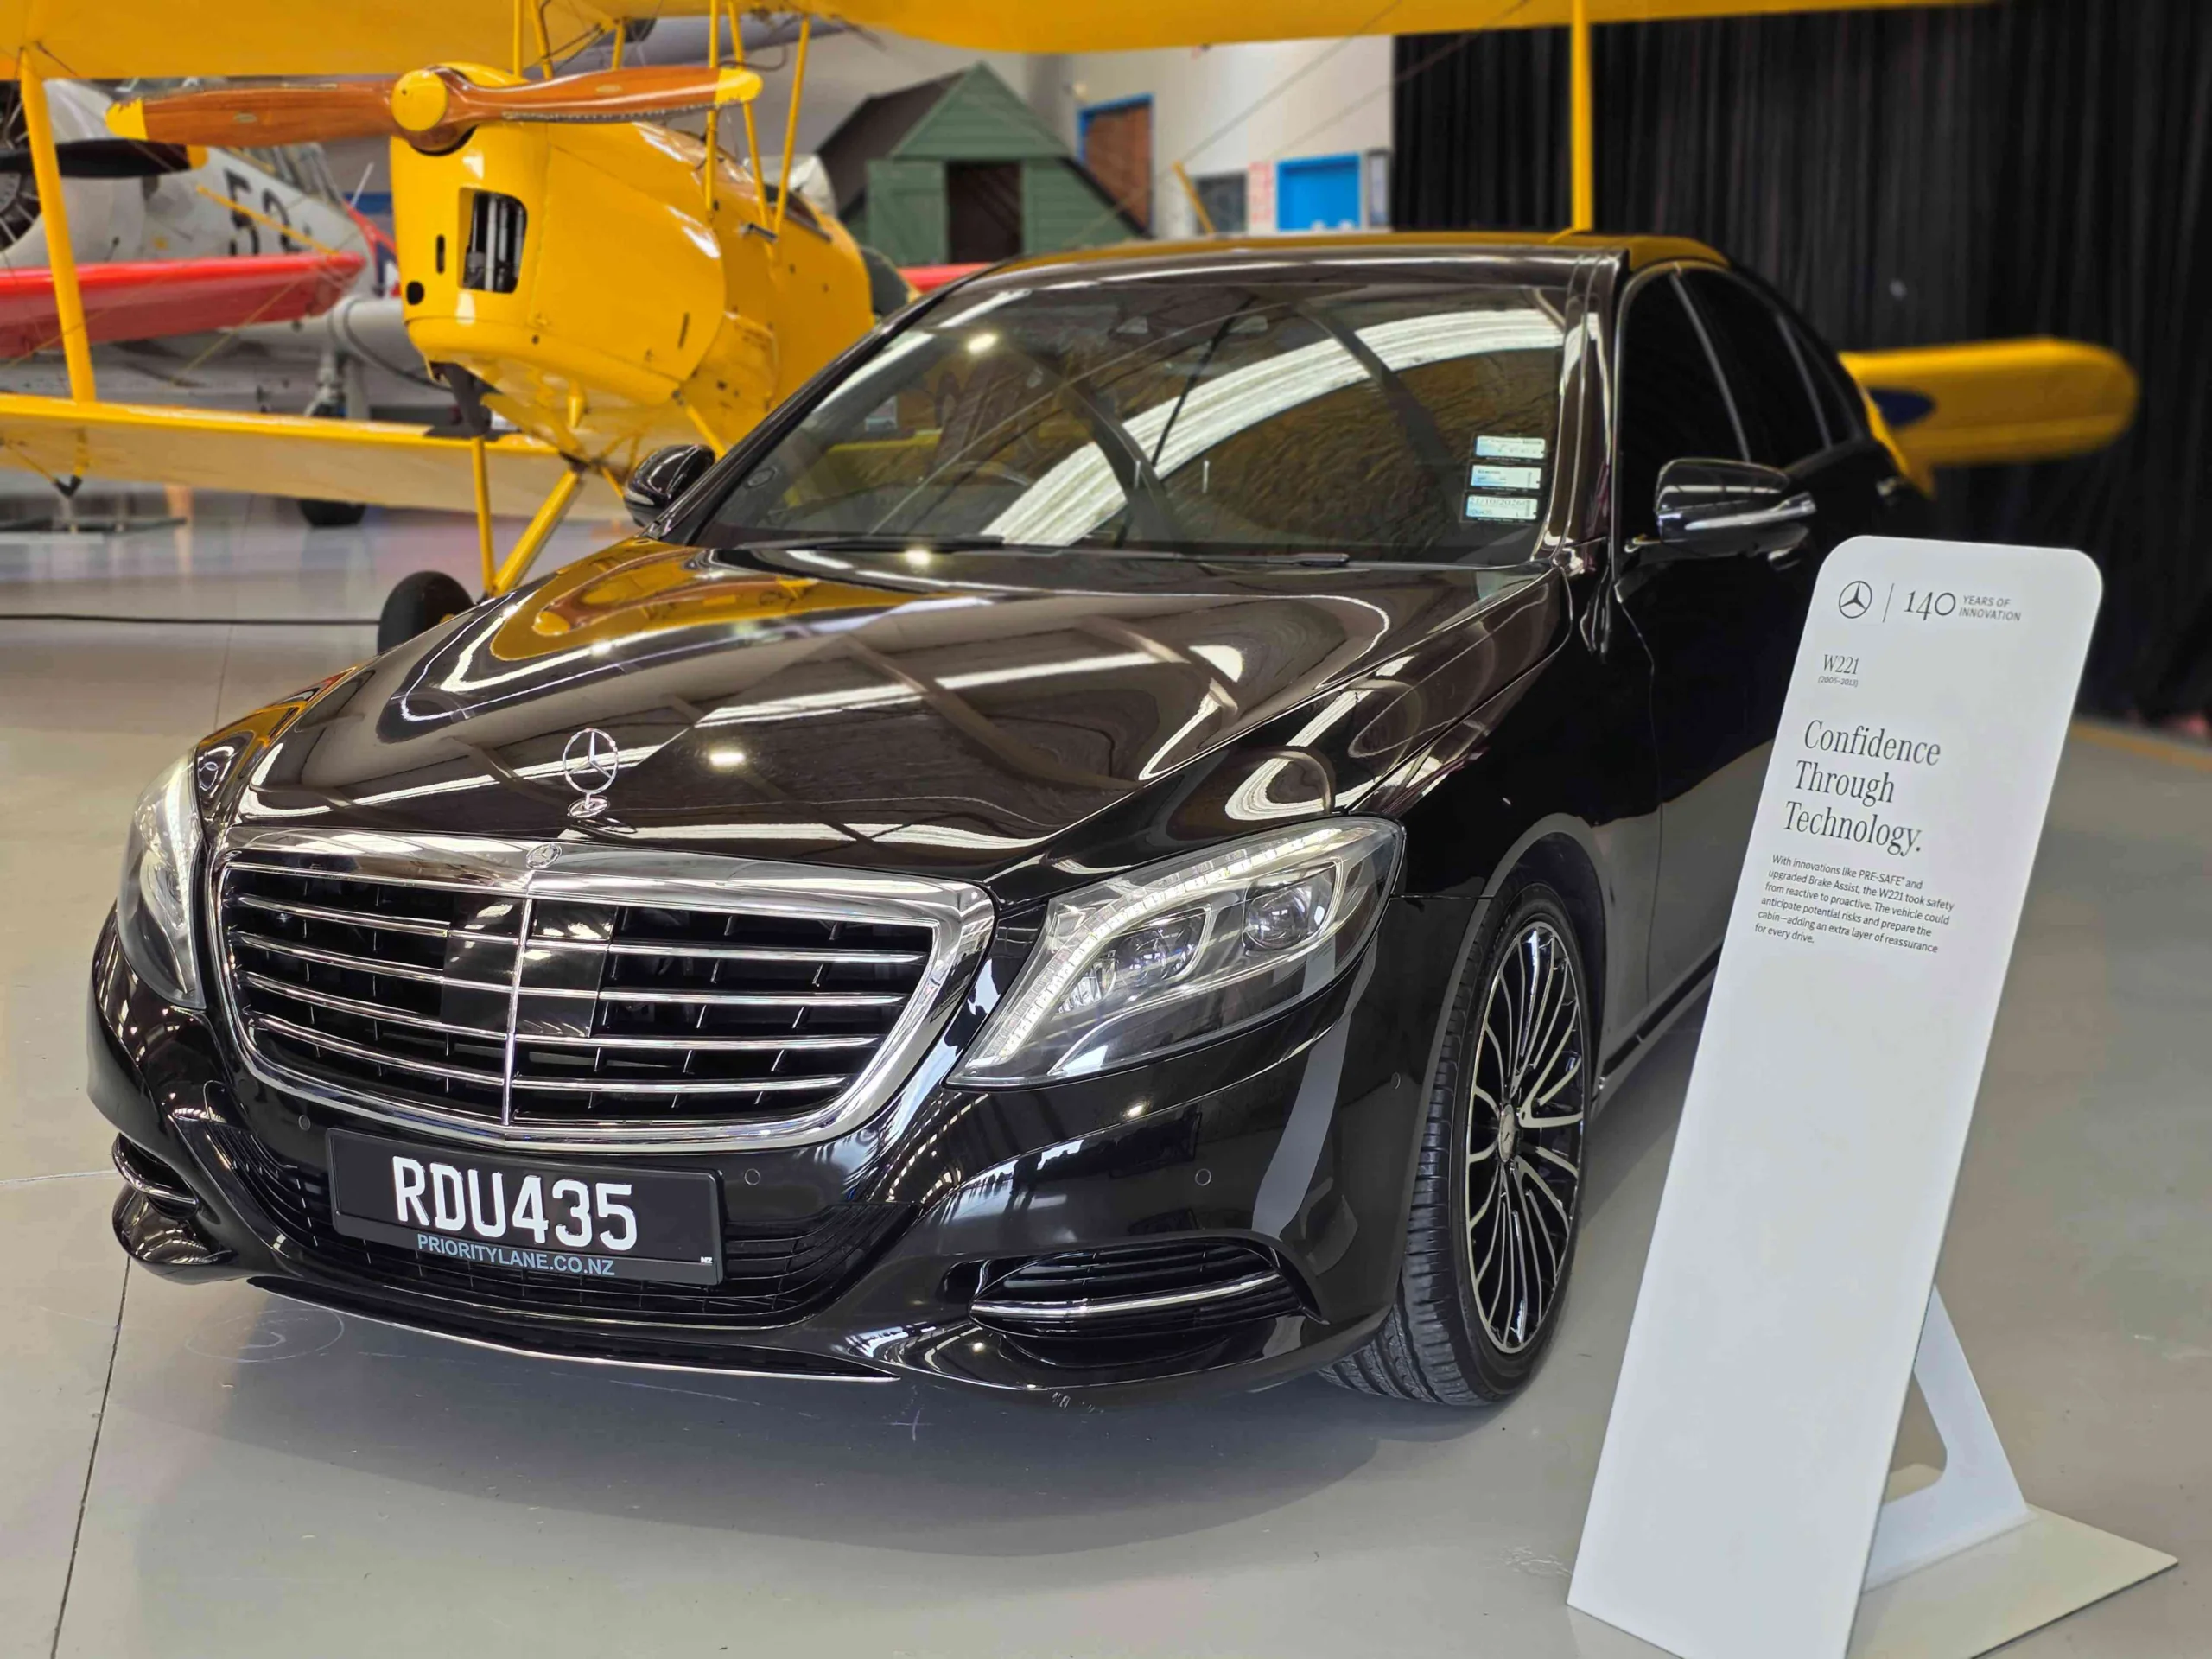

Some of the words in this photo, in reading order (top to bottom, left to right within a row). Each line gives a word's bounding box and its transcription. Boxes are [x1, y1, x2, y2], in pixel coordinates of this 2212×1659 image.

[1904, 590, 1956, 620] 140
[1959, 607, 2021, 621] INNOVATION
[1963, 595, 1994, 607] YEARS
[1996, 598, 2011, 607] OF
[1823, 654, 1859, 675] W221
[1804, 719, 1941, 766] Confidence
[1795, 760, 1894, 807] Through
[1783, 801, 1922, 857] Technology.
[1769, 870, 1808, 883] upgraded
[1808, 875, 1832, 888] Brake
[1833, 880, 1859, 894] Assist,
[1863, 886, 1877, 896] the
[1879, 888, 1903, 900] W221
[1905, 894, 1925, 906] took
[1926, 899, 1955, 912] safety
[1772, 855, 1791, 866] With
[1793, 858, 1840, 874] innovations
[1842, 867, 1857, 878] like
[1905, 880, 1923, 889] and
[1762, 897, 1802, 911] anticipate
[1802, 906, 1840, 918] potential
[1842, 912, 1861, 923] risks
[1863, 917, 1880, 926] and
[1881, 920, 1915, 933] prepare
[1917, 925, 1932, 937] the
[1765, 881, 1783, 893] from
[1786, 887, 1818, 899] reactive
[1830, 896, 1872, 910] proactive.
[1874, 902, 1890, 913] The
[1892, 907, 1923, 919] vehicle
[1924, 913, 1950, 925] could
[1755, 923, 1766, 932] for
[1768, 927, 1790, 940] every
[1791, 931, 1815, 943] drive.
[1828, 925, 1850, 936] extra
[1852, 927, 1873, 940] layer
[1874, 933, 1884, 942] of
[1885, 937, 1938, 953] reassurance
[392, 1155, 638, 1251] RDU435
[417, 1233, 615, 1276] PRIORITYLANE.CO.NZ
